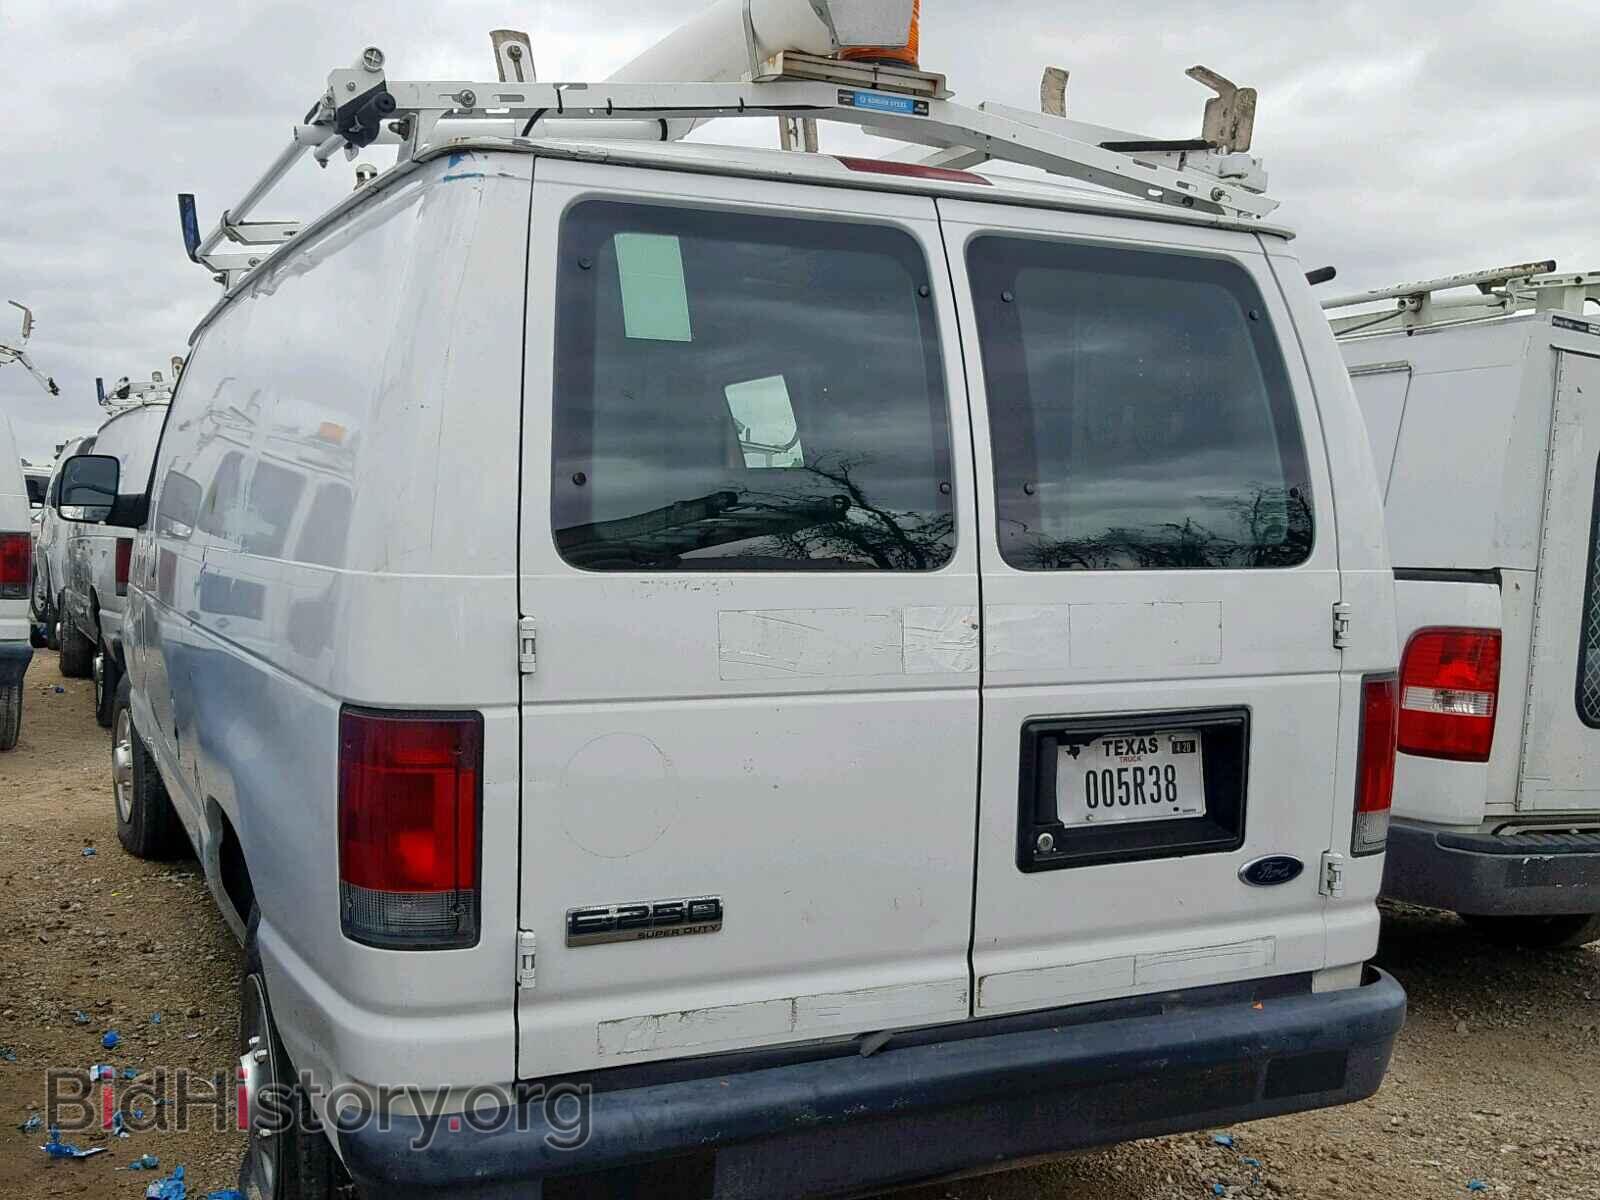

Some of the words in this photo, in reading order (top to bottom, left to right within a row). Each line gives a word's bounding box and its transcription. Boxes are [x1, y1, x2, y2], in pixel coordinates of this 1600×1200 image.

[1102, 737, 1159, 757] TEXAS
[1119, 755, 1142, 763] TRUCK
[1085, 764, 1177, 809] 005R38
[637, 928, 680, 940] SUPER
[683, 924, 719, 936] DUTY
